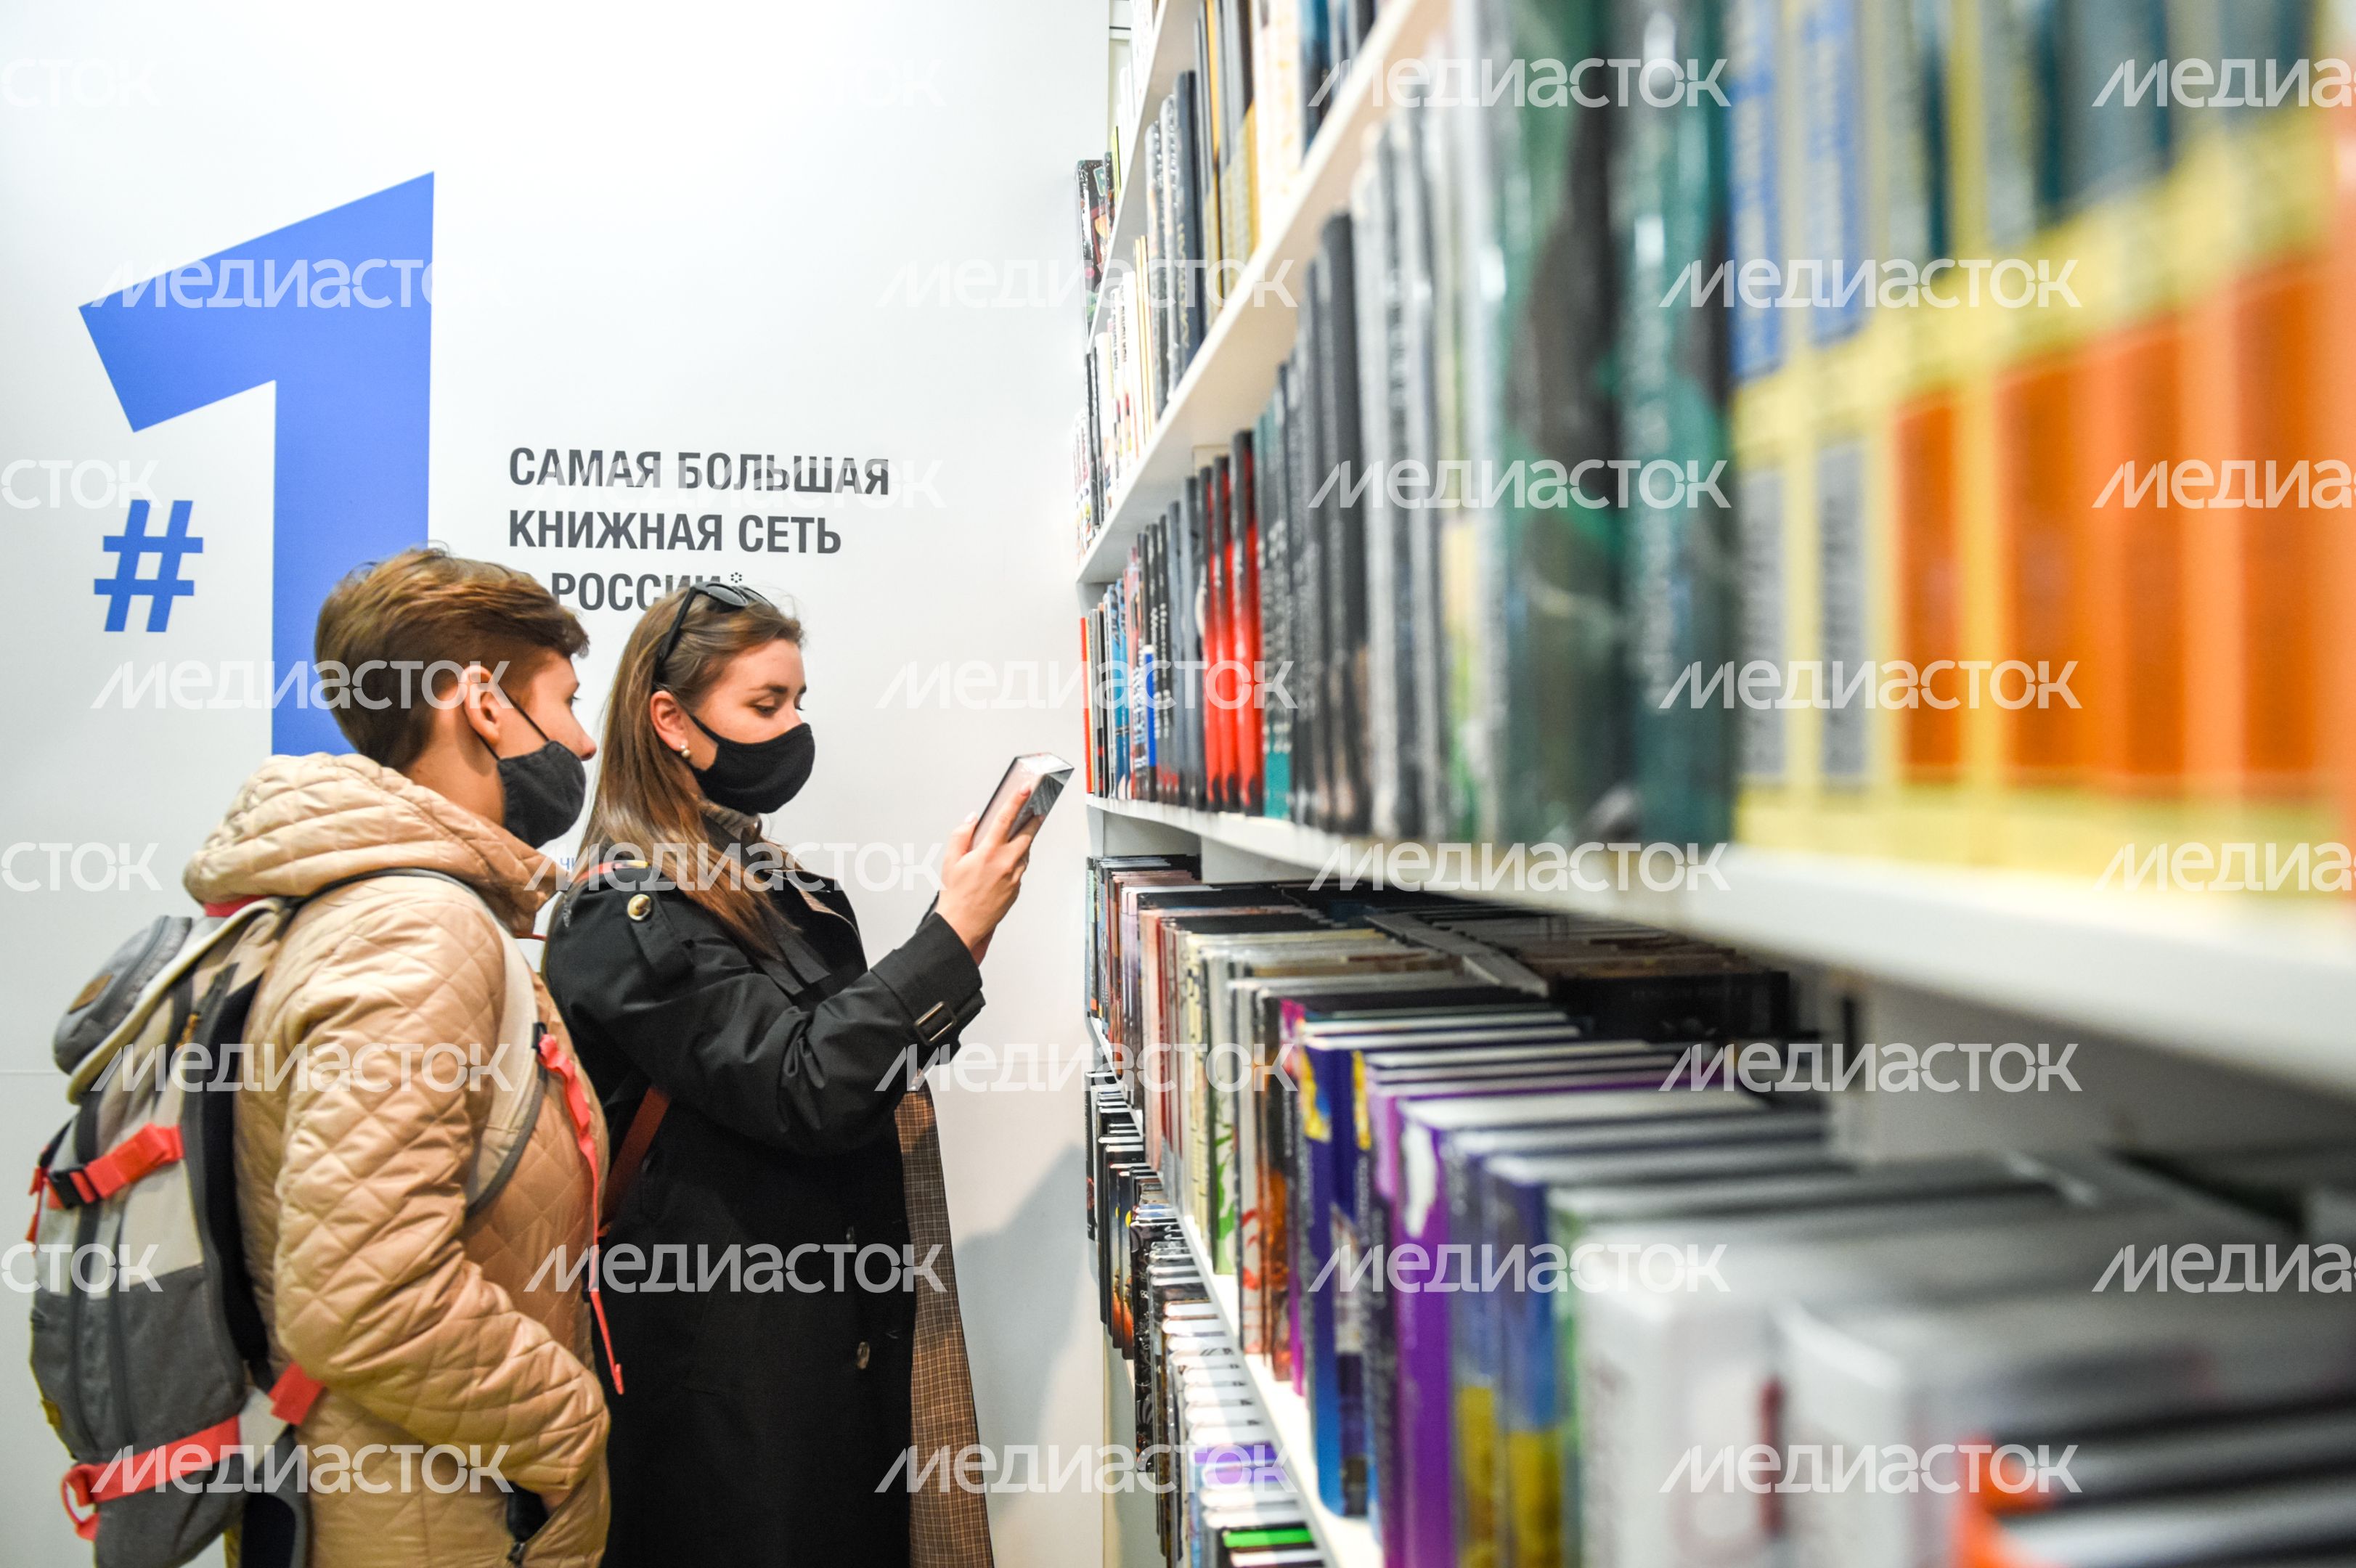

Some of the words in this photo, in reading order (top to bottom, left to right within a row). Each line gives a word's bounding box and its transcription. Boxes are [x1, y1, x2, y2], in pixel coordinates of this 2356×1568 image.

[509, 446, 661, 488] САМАЯ
[678, 452, 889, 495] БОЛЬШАЯ
[509, 510, 722, 552] КНИЖНАЯ
[738, 515, 842, 555] СЕТЬ
